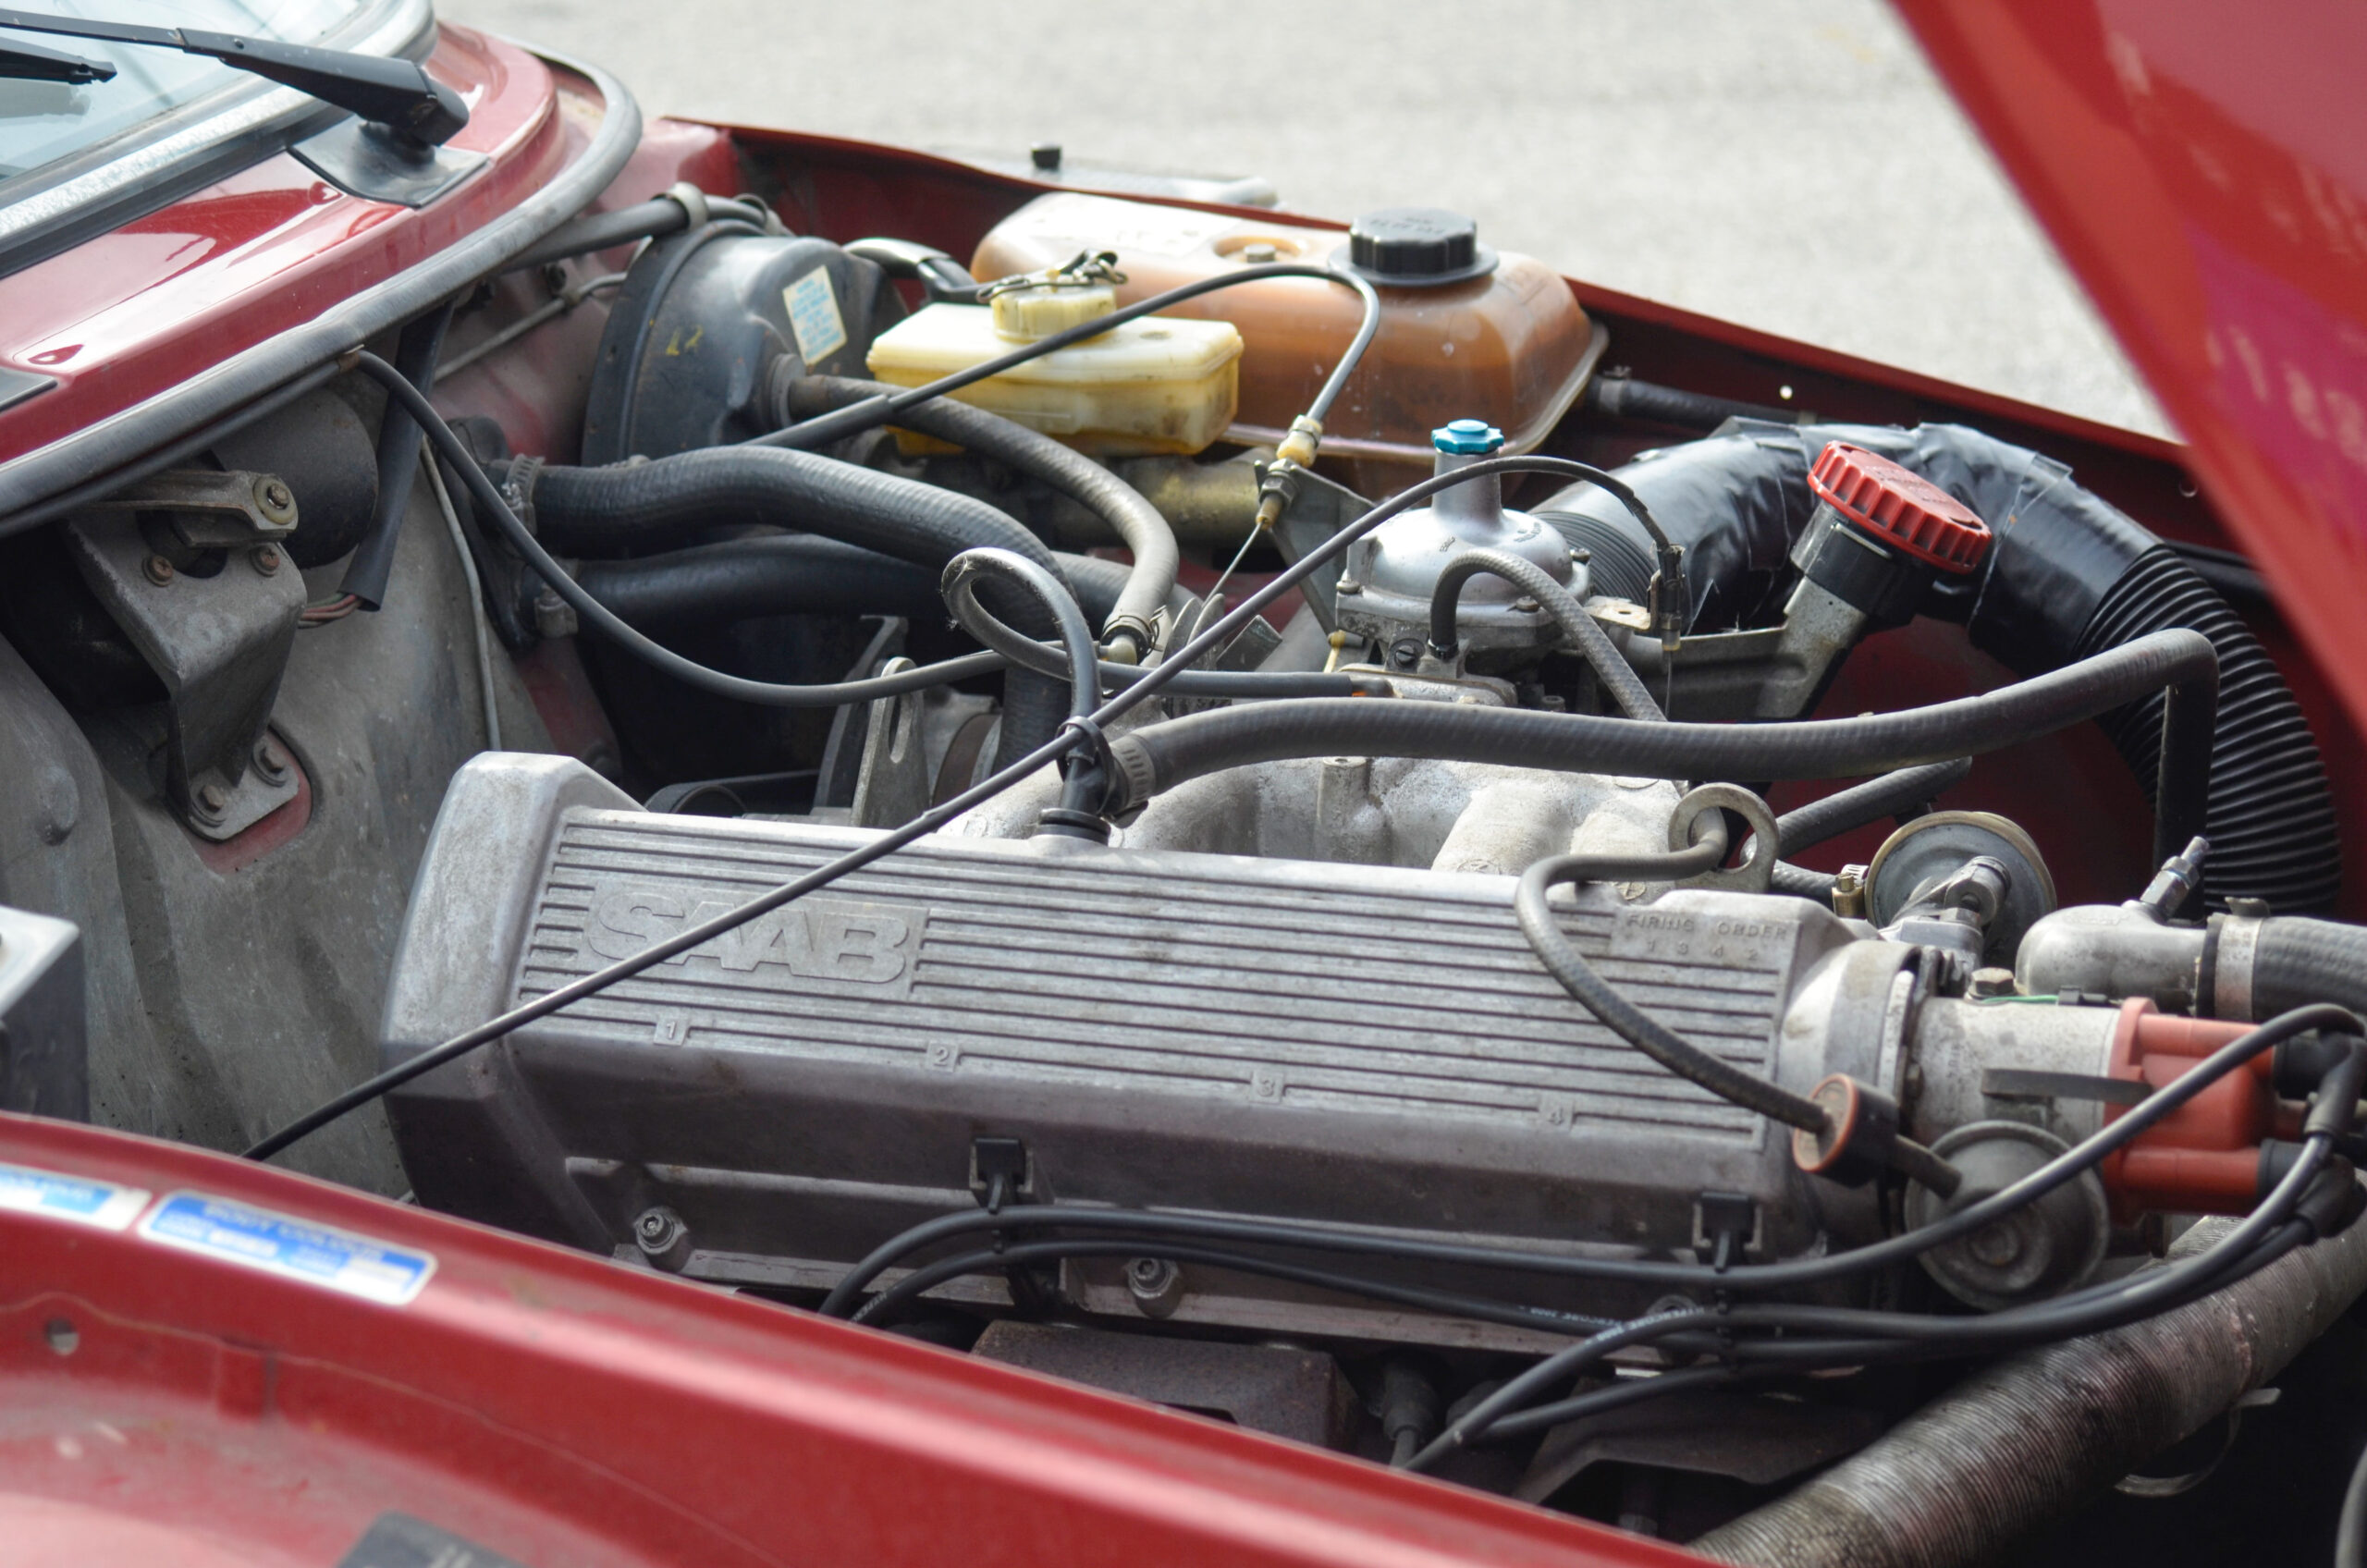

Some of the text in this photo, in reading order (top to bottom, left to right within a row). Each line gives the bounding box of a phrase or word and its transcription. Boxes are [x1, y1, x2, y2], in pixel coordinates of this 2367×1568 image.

[587, 890, 909, 985] SAAB
[1626, 914, 1787, 940] FIRING ORDER
[1647, 940, 1760, 962] 1 3 4 2
[666, 1021, 677, 1040] 1
[933, 1047, 950, 1067] 2
[1257, 1077, 1275, 1098] 3
[1547, 1106, 1564, 1127] 4
